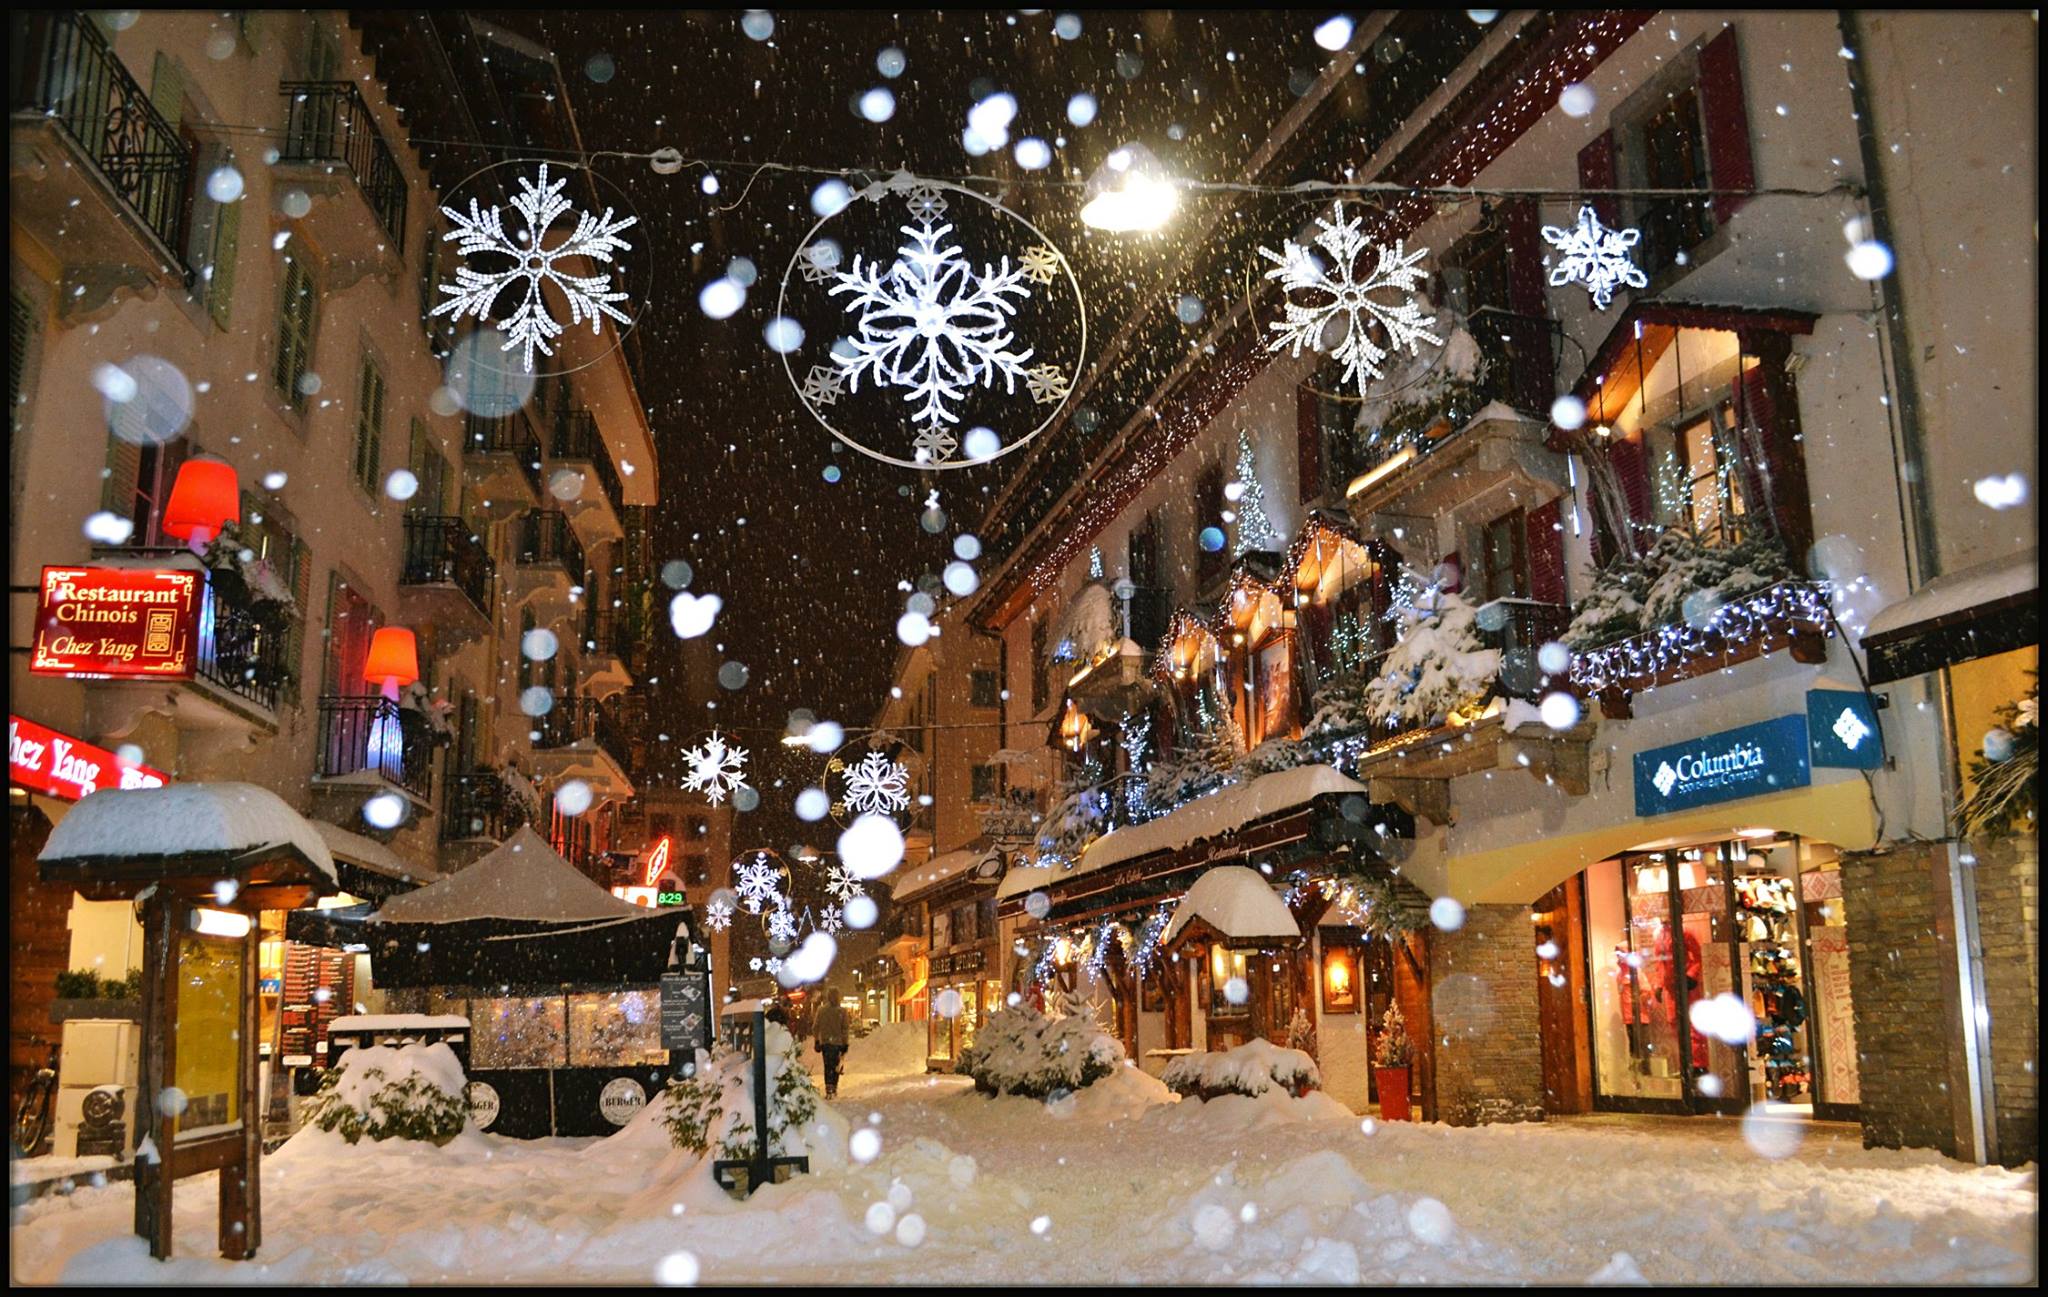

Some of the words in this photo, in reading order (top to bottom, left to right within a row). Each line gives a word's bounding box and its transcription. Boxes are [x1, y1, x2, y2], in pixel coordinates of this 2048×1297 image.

[61, 583, 180, 604] Restaurant
[56, 603, 138, 623] Chinois
[51, 636, 94, 655] Chez
[98, 638, 138, 661] Yang
[51, 738, 101, 797] Yang
[1676, 742, 1764, 782] Columbia
[658, 893, 683, 904] 8:29
